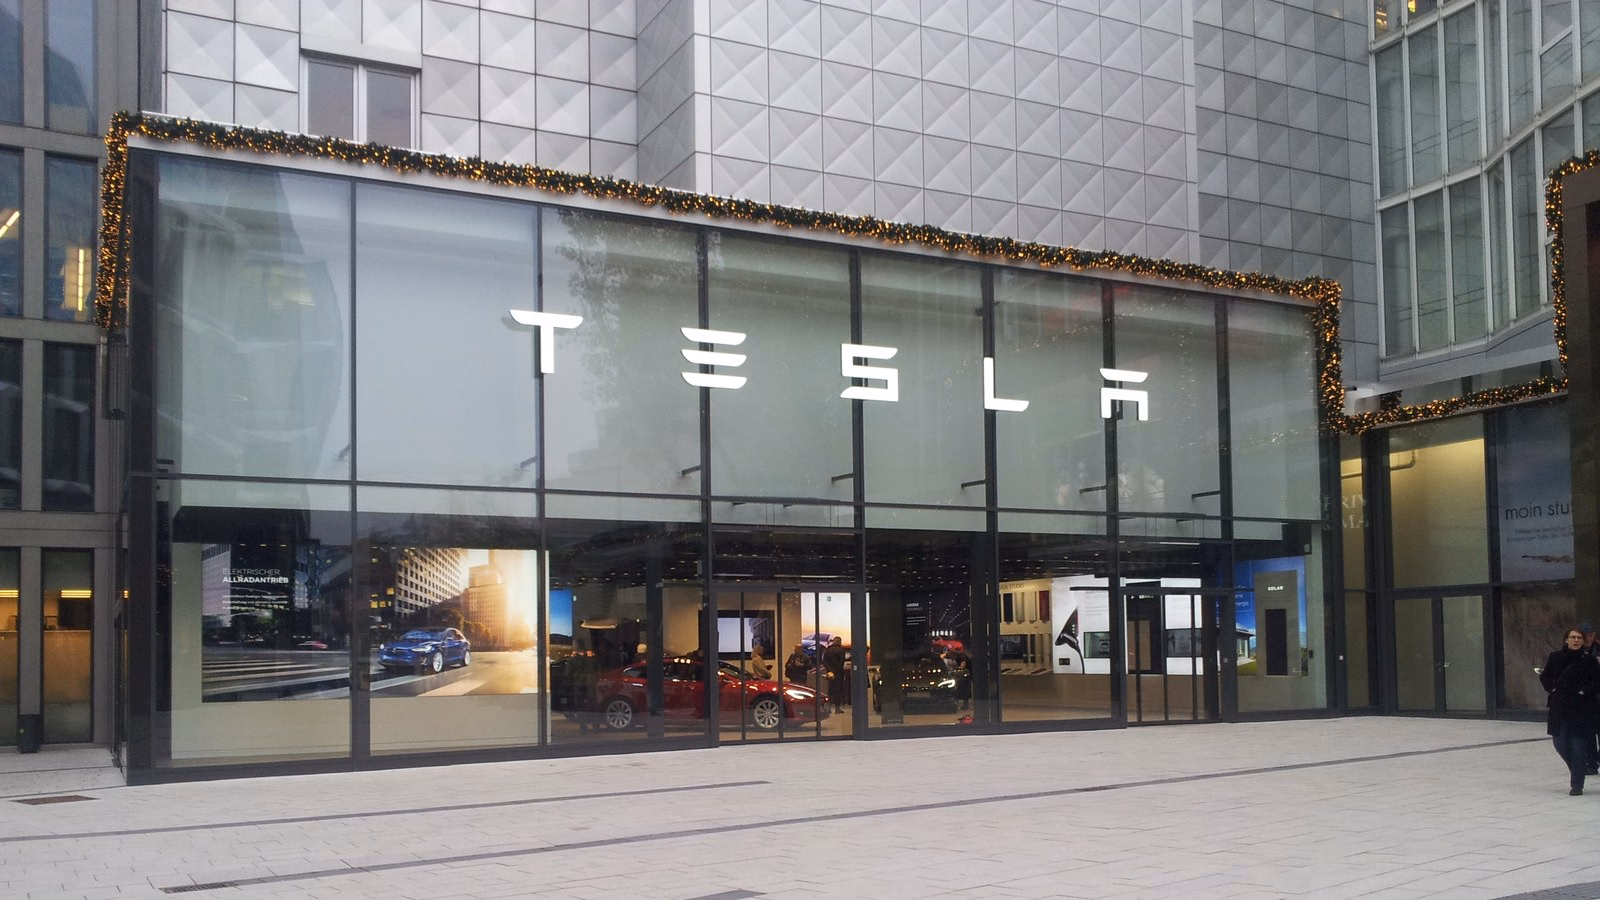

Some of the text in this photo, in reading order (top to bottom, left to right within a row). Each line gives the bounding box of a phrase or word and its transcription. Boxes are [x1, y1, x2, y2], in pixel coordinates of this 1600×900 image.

[509, 308, 1149, 422] TESLA
[1505, 502, 1542, 520] moin
[222, 576, 289, 584] ALLRADANTRIEB
